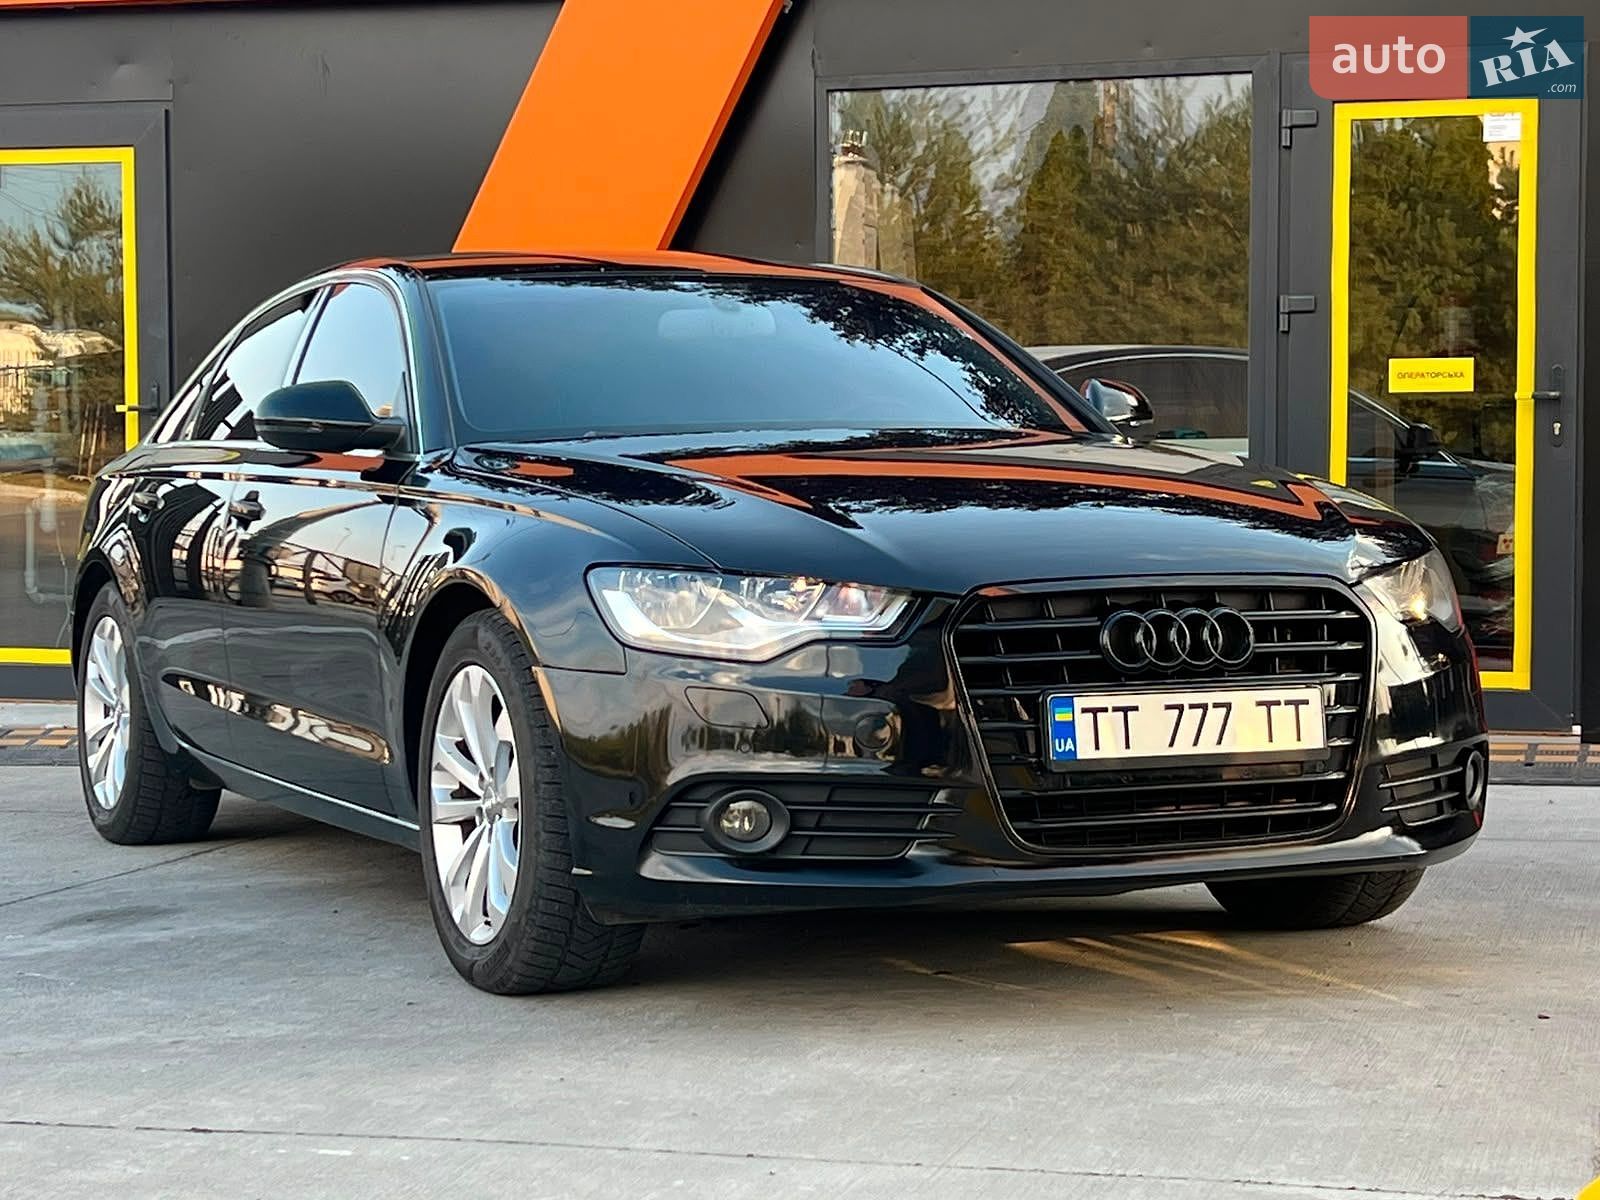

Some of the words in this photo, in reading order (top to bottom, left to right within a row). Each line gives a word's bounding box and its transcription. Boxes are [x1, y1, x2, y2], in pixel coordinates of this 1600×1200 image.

[1081, 705, 1139, 751] TT
[1164, 702, 1232, 747] 777
[1255, 699, 1309, 743] TT
[1055, 738, 1074, 752] UA
